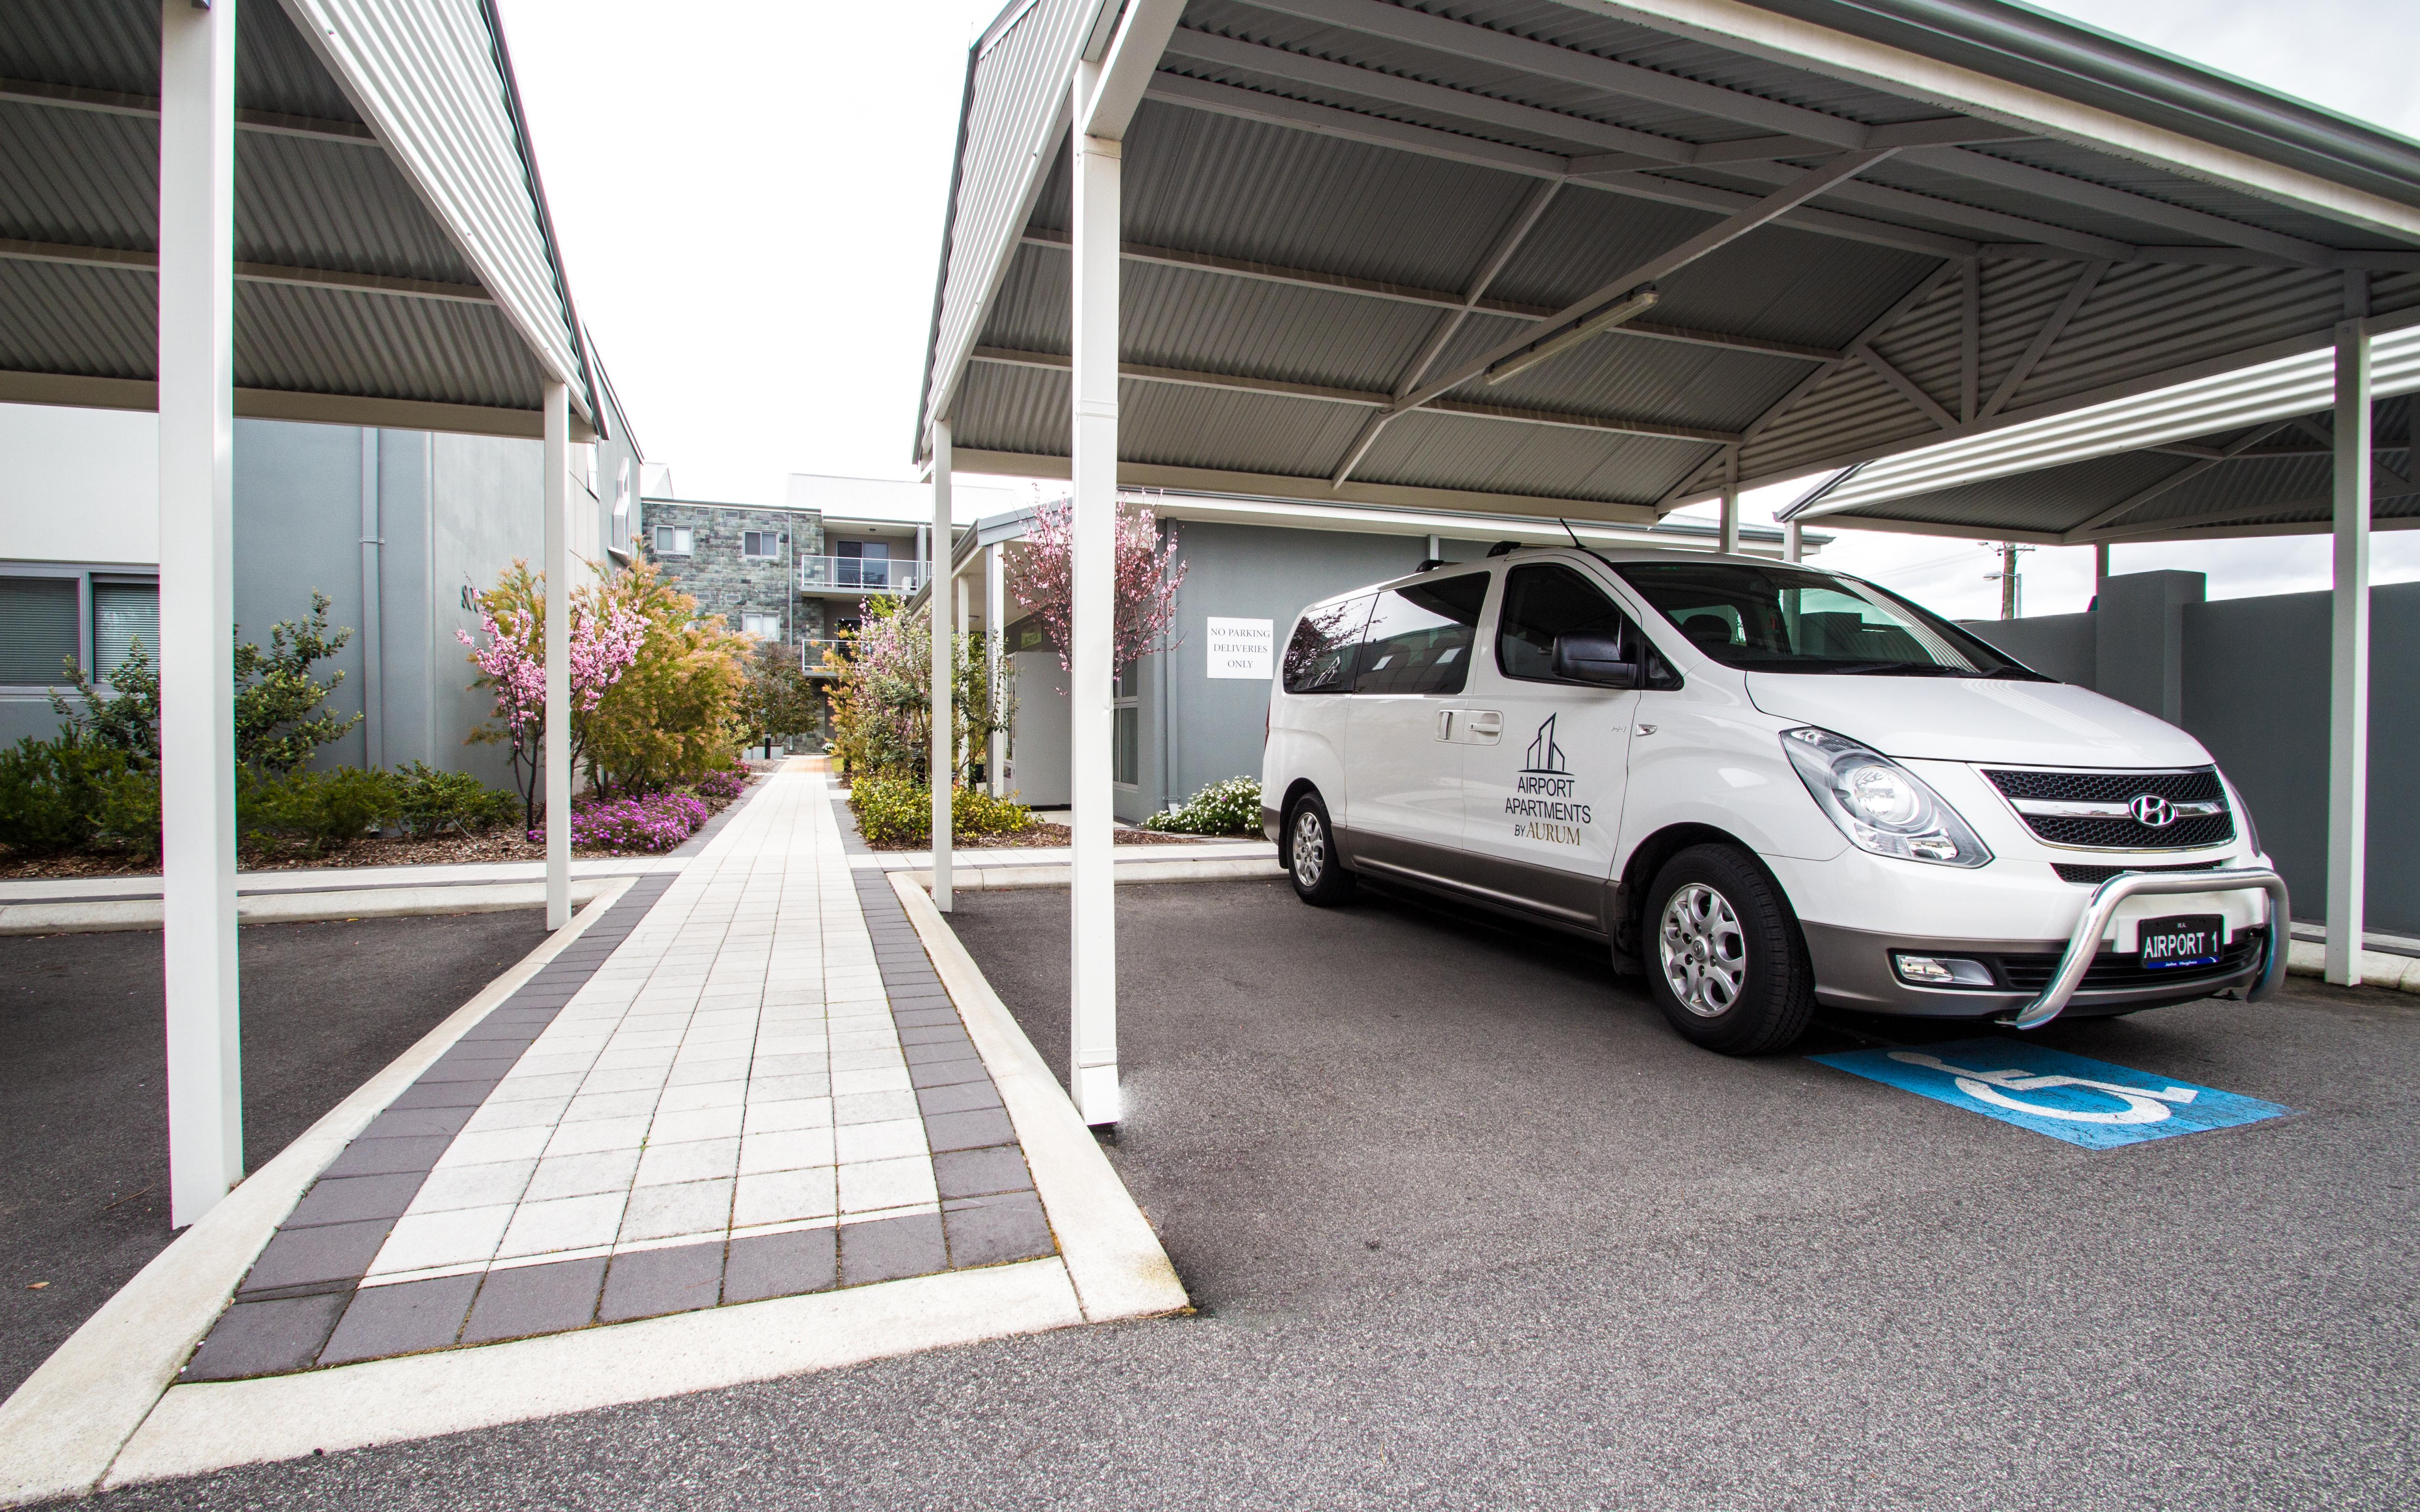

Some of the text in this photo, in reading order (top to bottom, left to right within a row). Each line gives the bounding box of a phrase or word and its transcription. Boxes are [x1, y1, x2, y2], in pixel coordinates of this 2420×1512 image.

[1229, 629, 1270, 637] PARKING
[1214, 644, 1267, 653] DELIVERIES
[1227, 660, 1253, 668] ONLY
[1517, 776, 1575, 798] AIRPORT
[1505, 797, 1591, 824] APARTMENTS
[1514, 821, 1581, 846] BY AURUM
[2144, 931, 2217, 959] AIRPORT 1
